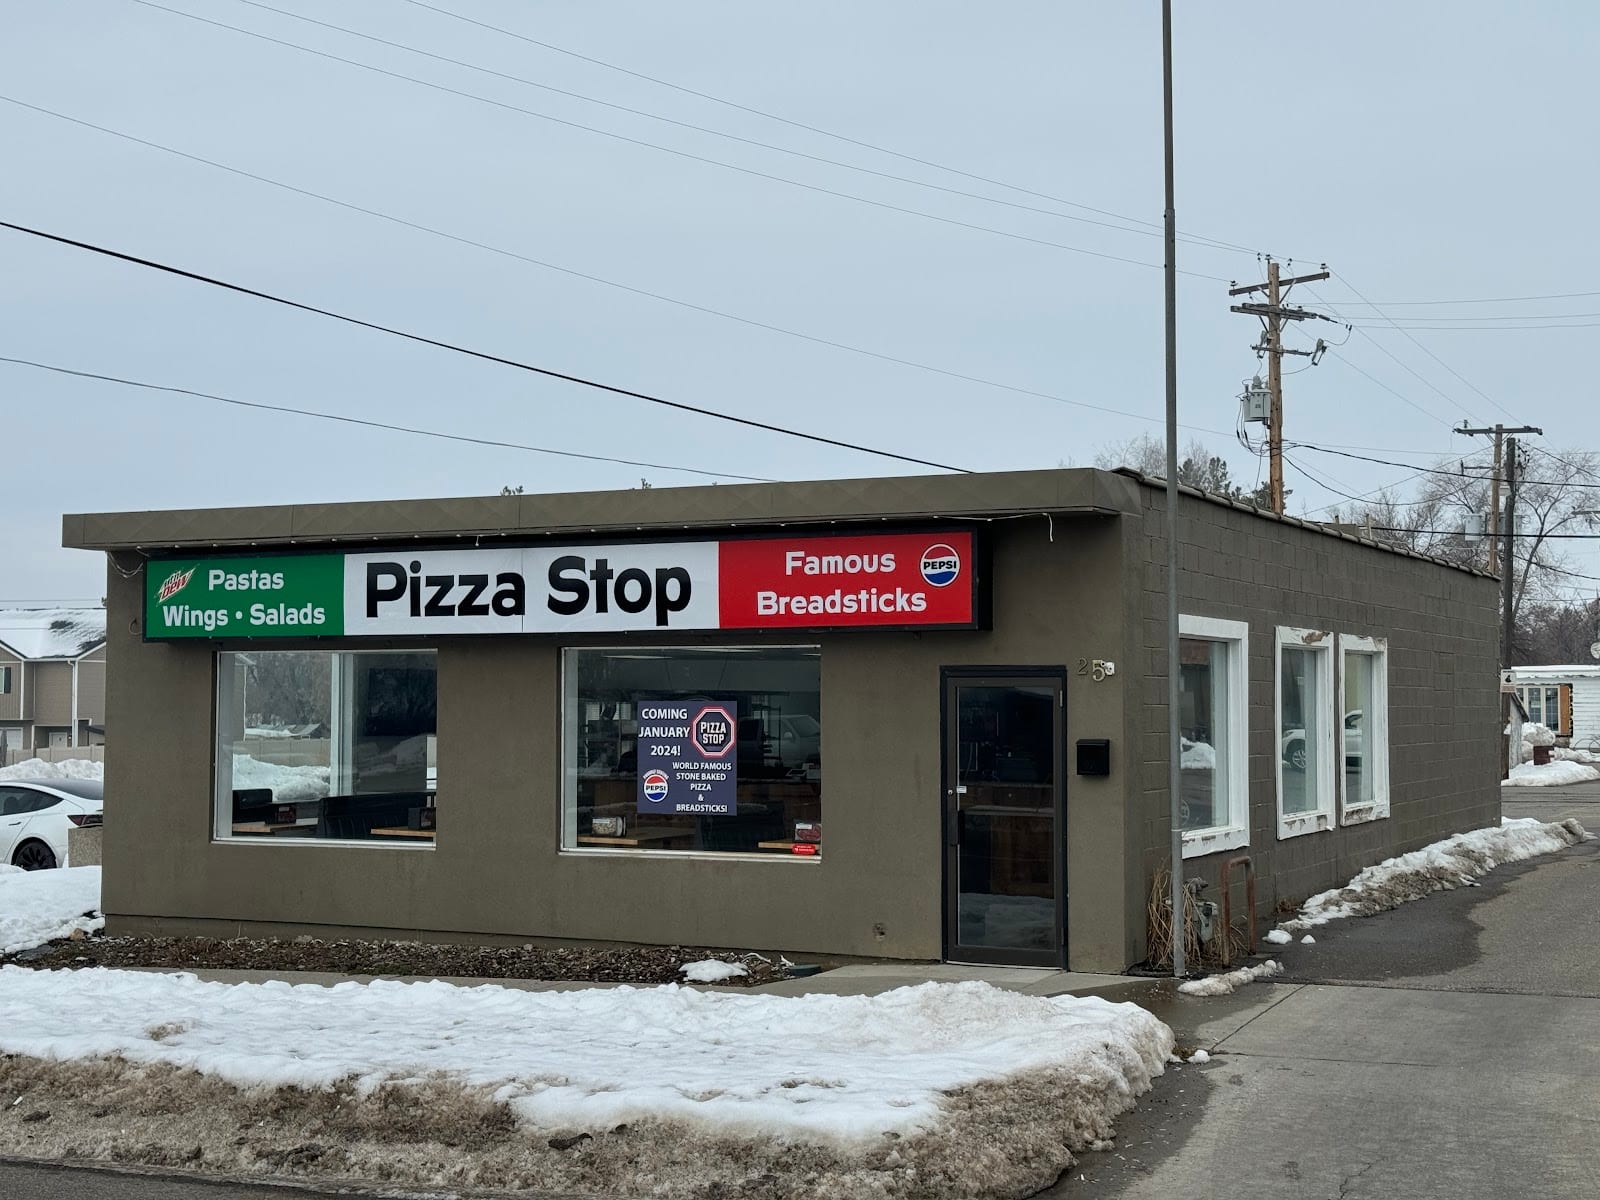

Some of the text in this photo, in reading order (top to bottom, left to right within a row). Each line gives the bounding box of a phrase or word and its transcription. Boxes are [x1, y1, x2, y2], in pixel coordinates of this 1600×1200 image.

[785, 550, 896, 576] Famous
[923, 559, 958, 571] PEPSI
[207, 569, 285, 592] Pastas
[366, 556, 692, 627] Pizza Stop
[756, 587, 927, 616] Breadsticks
[162, 602, 326, 632] Wings Salads
[641, 708, 688, 720] COMING
[638, 726, 690, 738] JANUARY
[700, 721, 727, 734] PIZZA
[702, 733, 725, 745] STOP
[650, 745, 681, 757] 2024!
[672, 761, 732, 772] WORLD FAMOUS
[676, 772, 700, 782] STONE
[701, 773, 727, 782] BAKED
[645, 784, 667, 792] PEPSI
[690, 783, 712, 792] PIZZA
[697, 793, 705, 802] &
[676, 803, 728, 813] BREADSTICKS!
